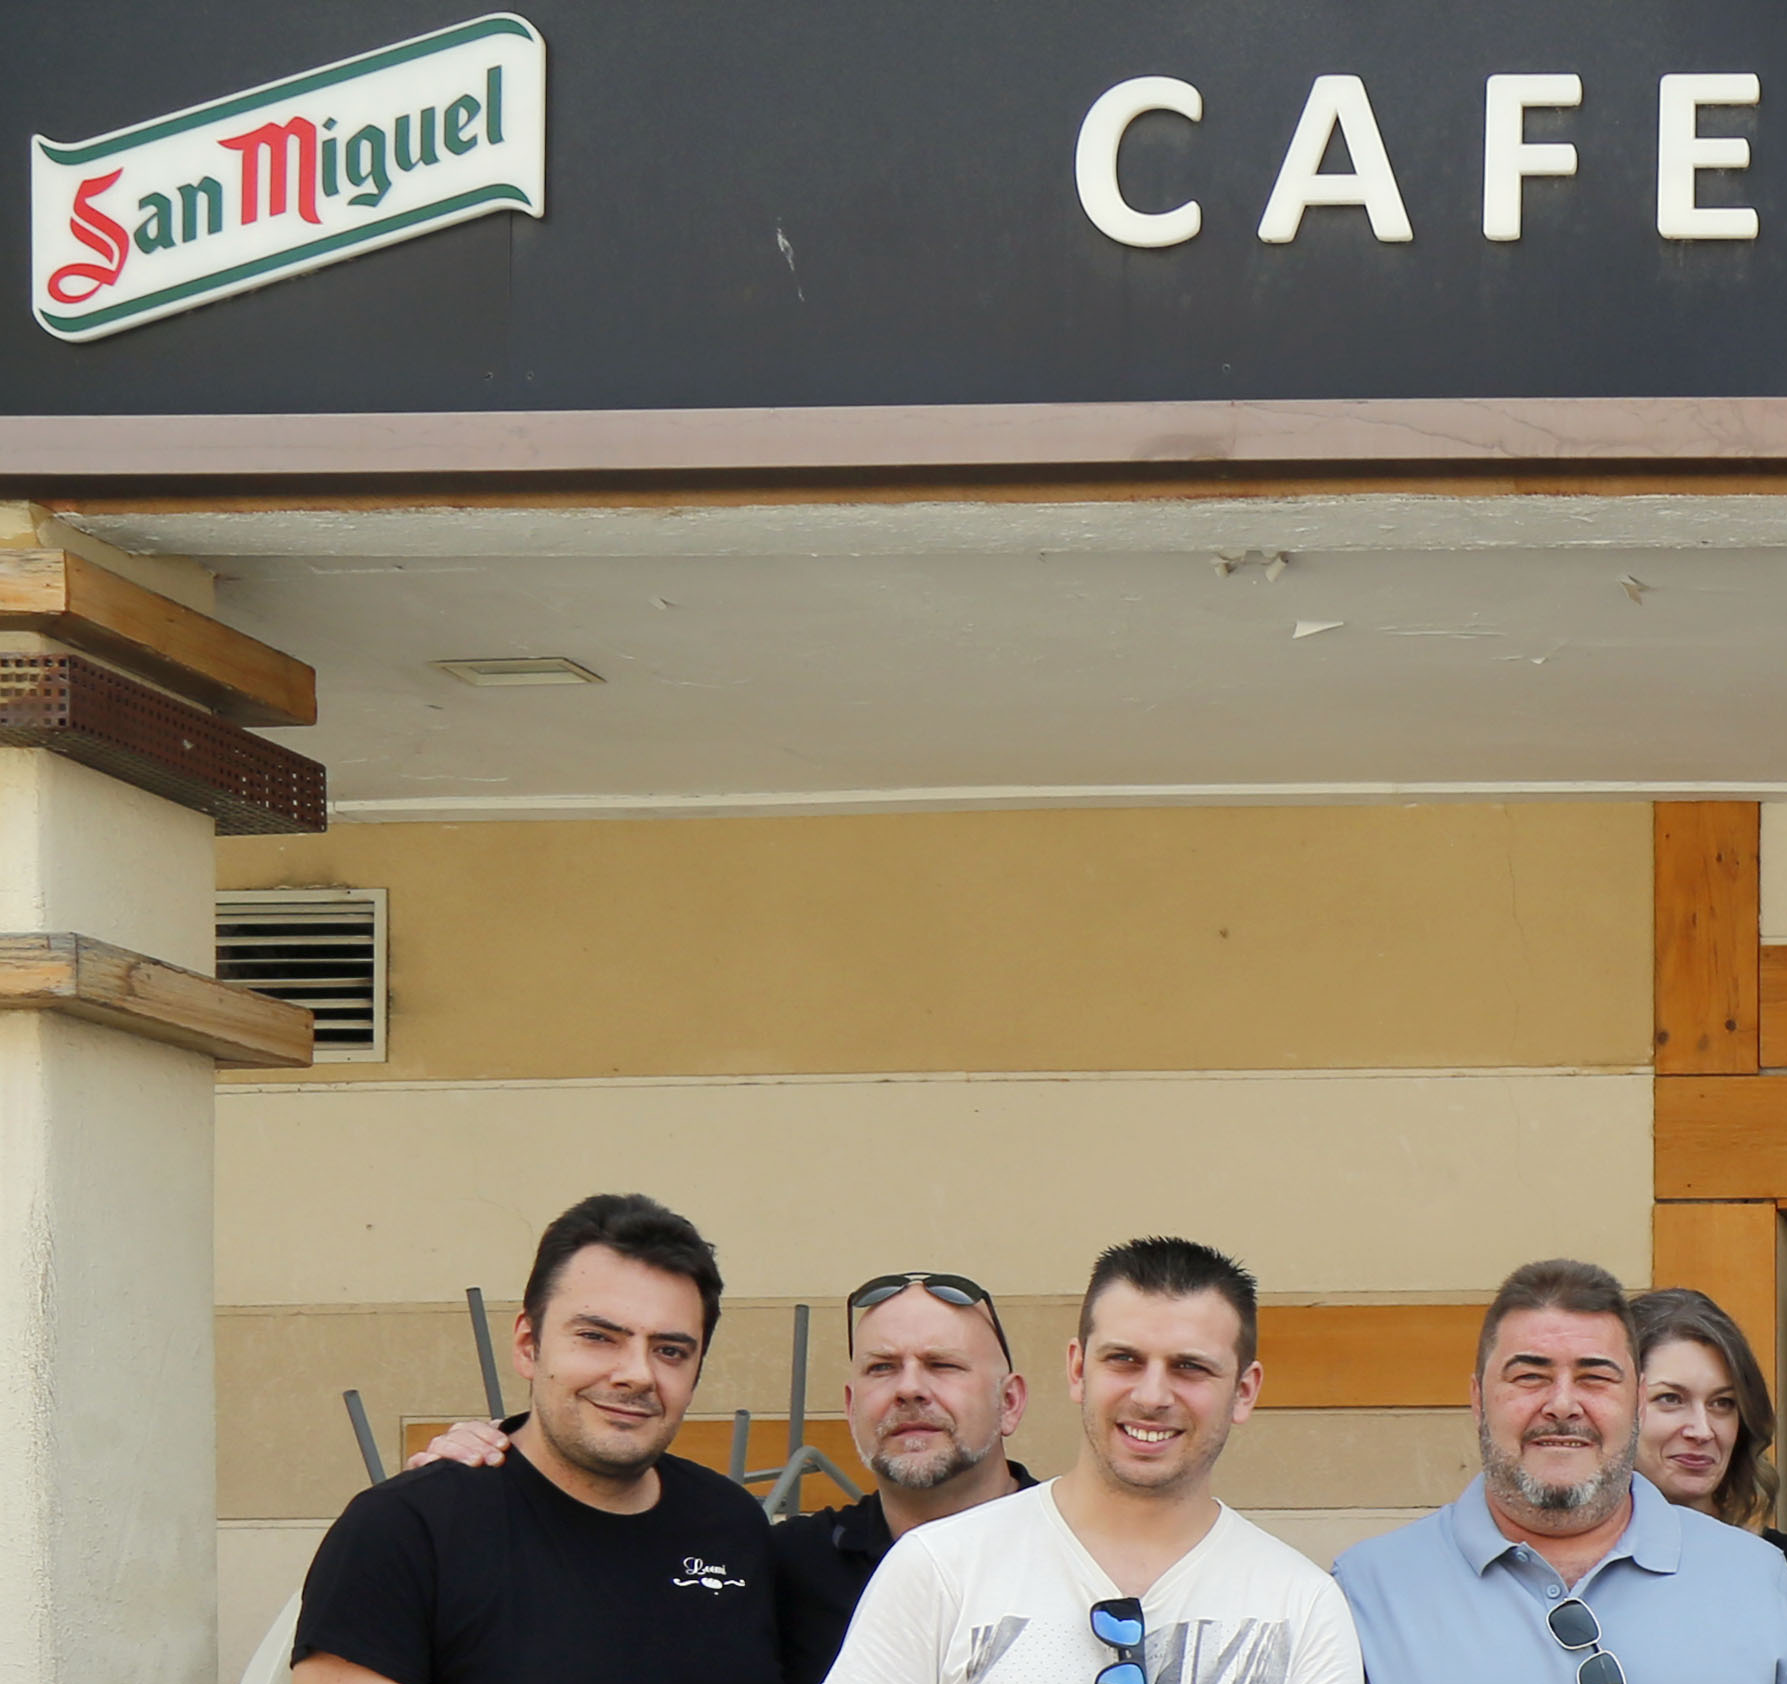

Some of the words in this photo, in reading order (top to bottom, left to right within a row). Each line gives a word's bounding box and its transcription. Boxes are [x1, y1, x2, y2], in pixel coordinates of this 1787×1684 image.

[46, 166, 225, 306] San
[219, 63, 505, 226] Miguel
[1074, 73, 1762, 249] CAFE
